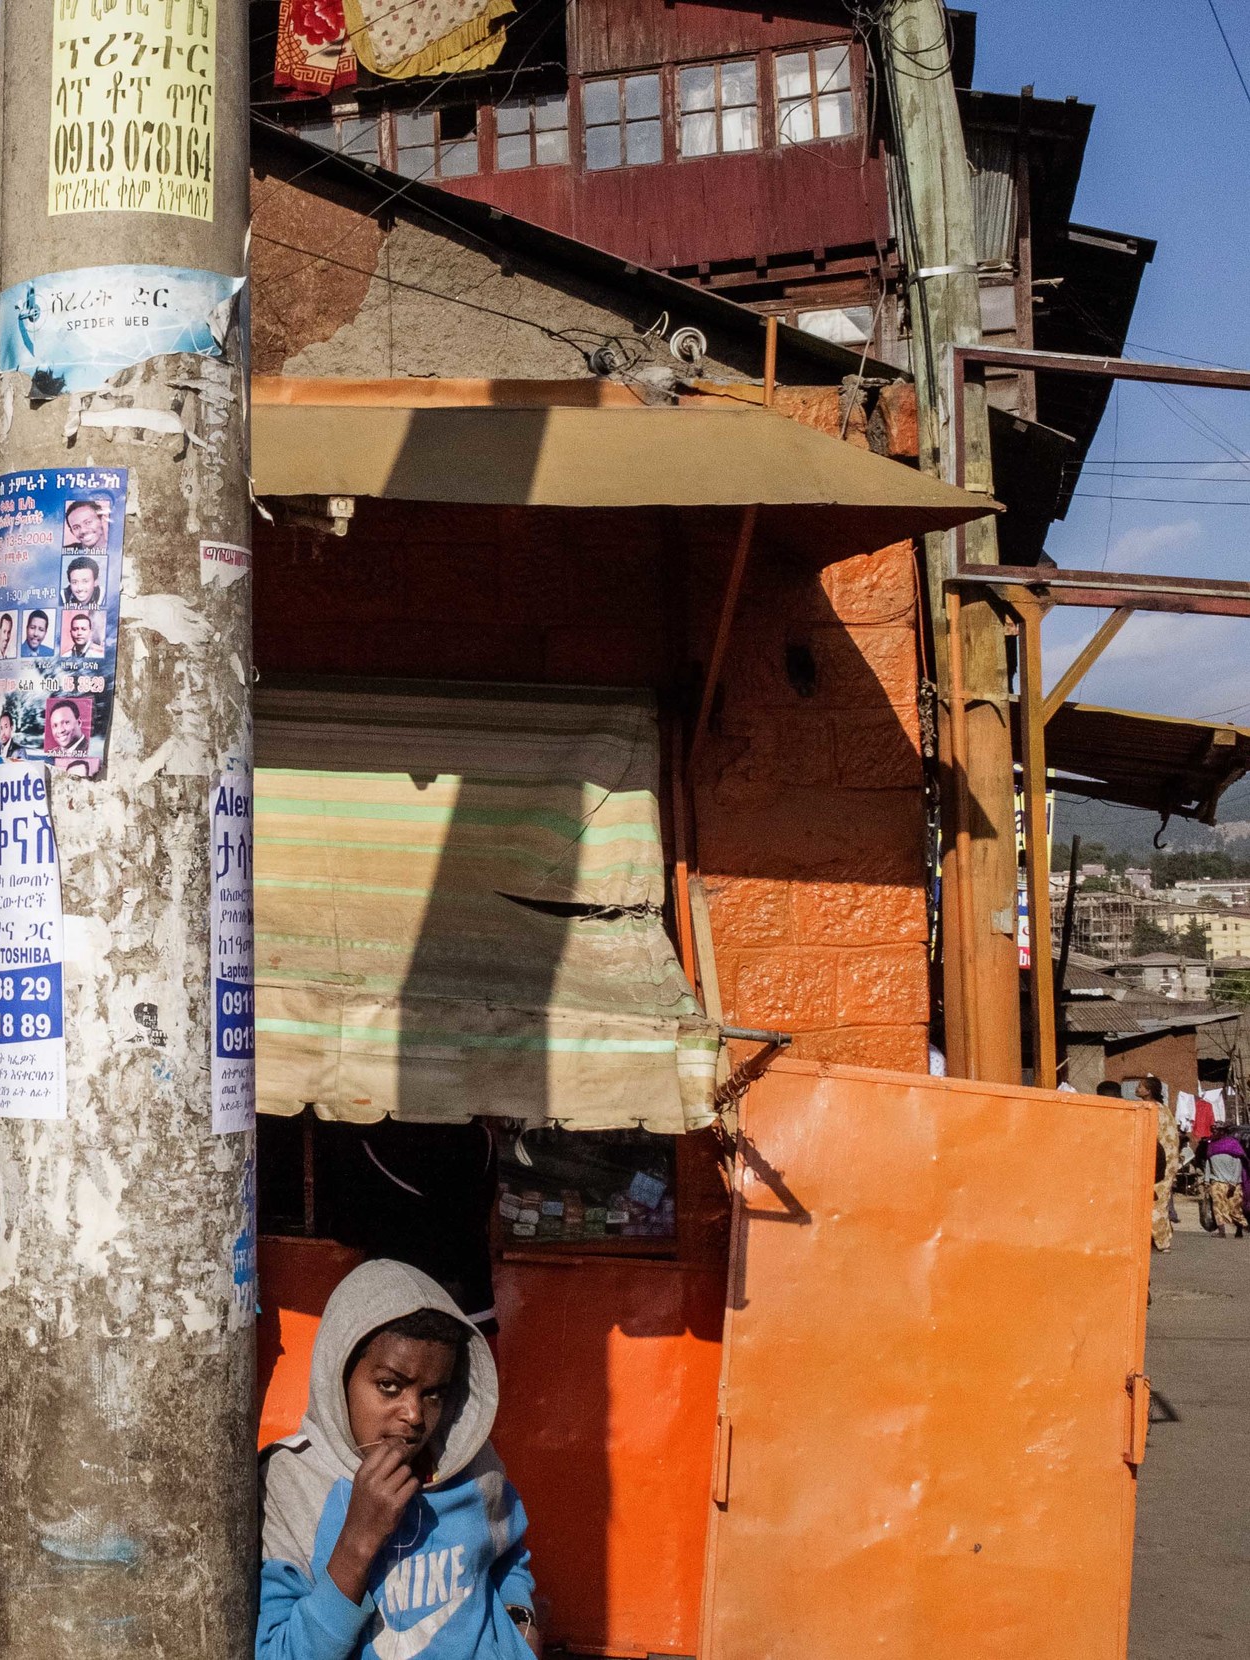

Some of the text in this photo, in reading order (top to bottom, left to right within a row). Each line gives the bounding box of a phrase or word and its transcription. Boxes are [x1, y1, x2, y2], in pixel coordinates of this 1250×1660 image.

[54, 119, 211, 182] 0913 078164
[66, 316, 149, 331] SPIDER WEB
[215, 786, 249, 818] Alex
[0, 947, 51, 964] TOSHIBA
[221, 962, 249, 982] Laptop
[21, 976, 51, 1001] 29
[222, 991, 254, 1015] 0911
[21, 1013, 51, 1038] 89
[384, 1544, 466, 1614] NIKE
